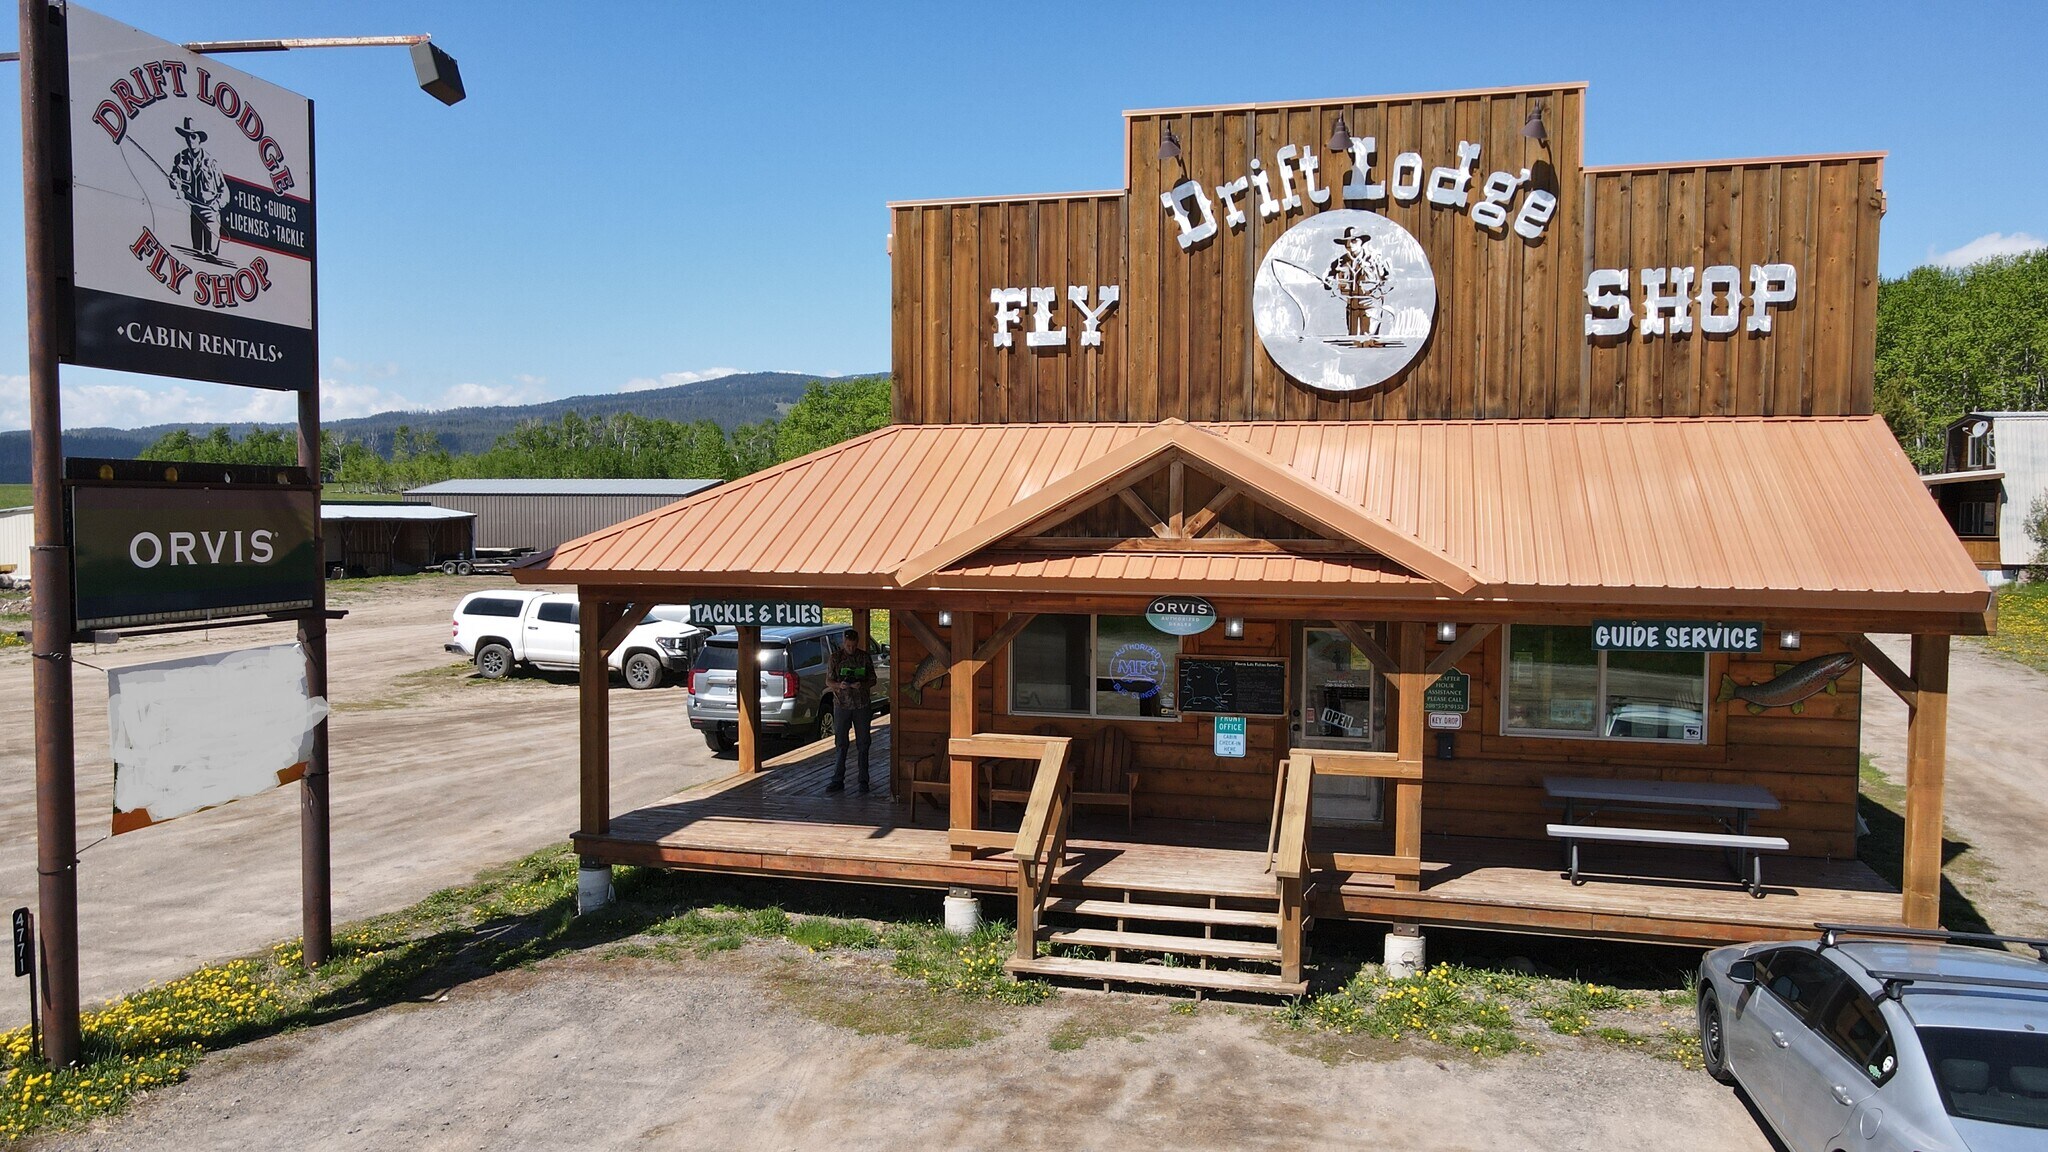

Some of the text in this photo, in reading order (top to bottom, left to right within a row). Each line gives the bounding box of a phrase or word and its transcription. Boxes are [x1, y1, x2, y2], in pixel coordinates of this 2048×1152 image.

[92, 60, 295, 197] DRIFT LODGE
[1160, 136, 1557, 250] Drift Lodge
[129, 226, 272, 308] FLY SHOP
[990, 263, 1797, 348] FLY SHOP
[126, 322, 277, 363] CABIN RENTALS
[129, 529, 274, 569] ORVIS
[692, 604, 821, 624] TACKLE & FLIES
[1154, 602, 1208, 615] ORVIS
[1115, 643, 1162, 659] AUTHORIZED
[1595, 626, 1758, 649] GUIDE SERVICE
[1117, 660, 1159, 675] MFC
[1219, 723, 1242, 731] OFFICE
[1324, 709, 1353, 729] OPEN
[15, 912, 25, 972] 4771
